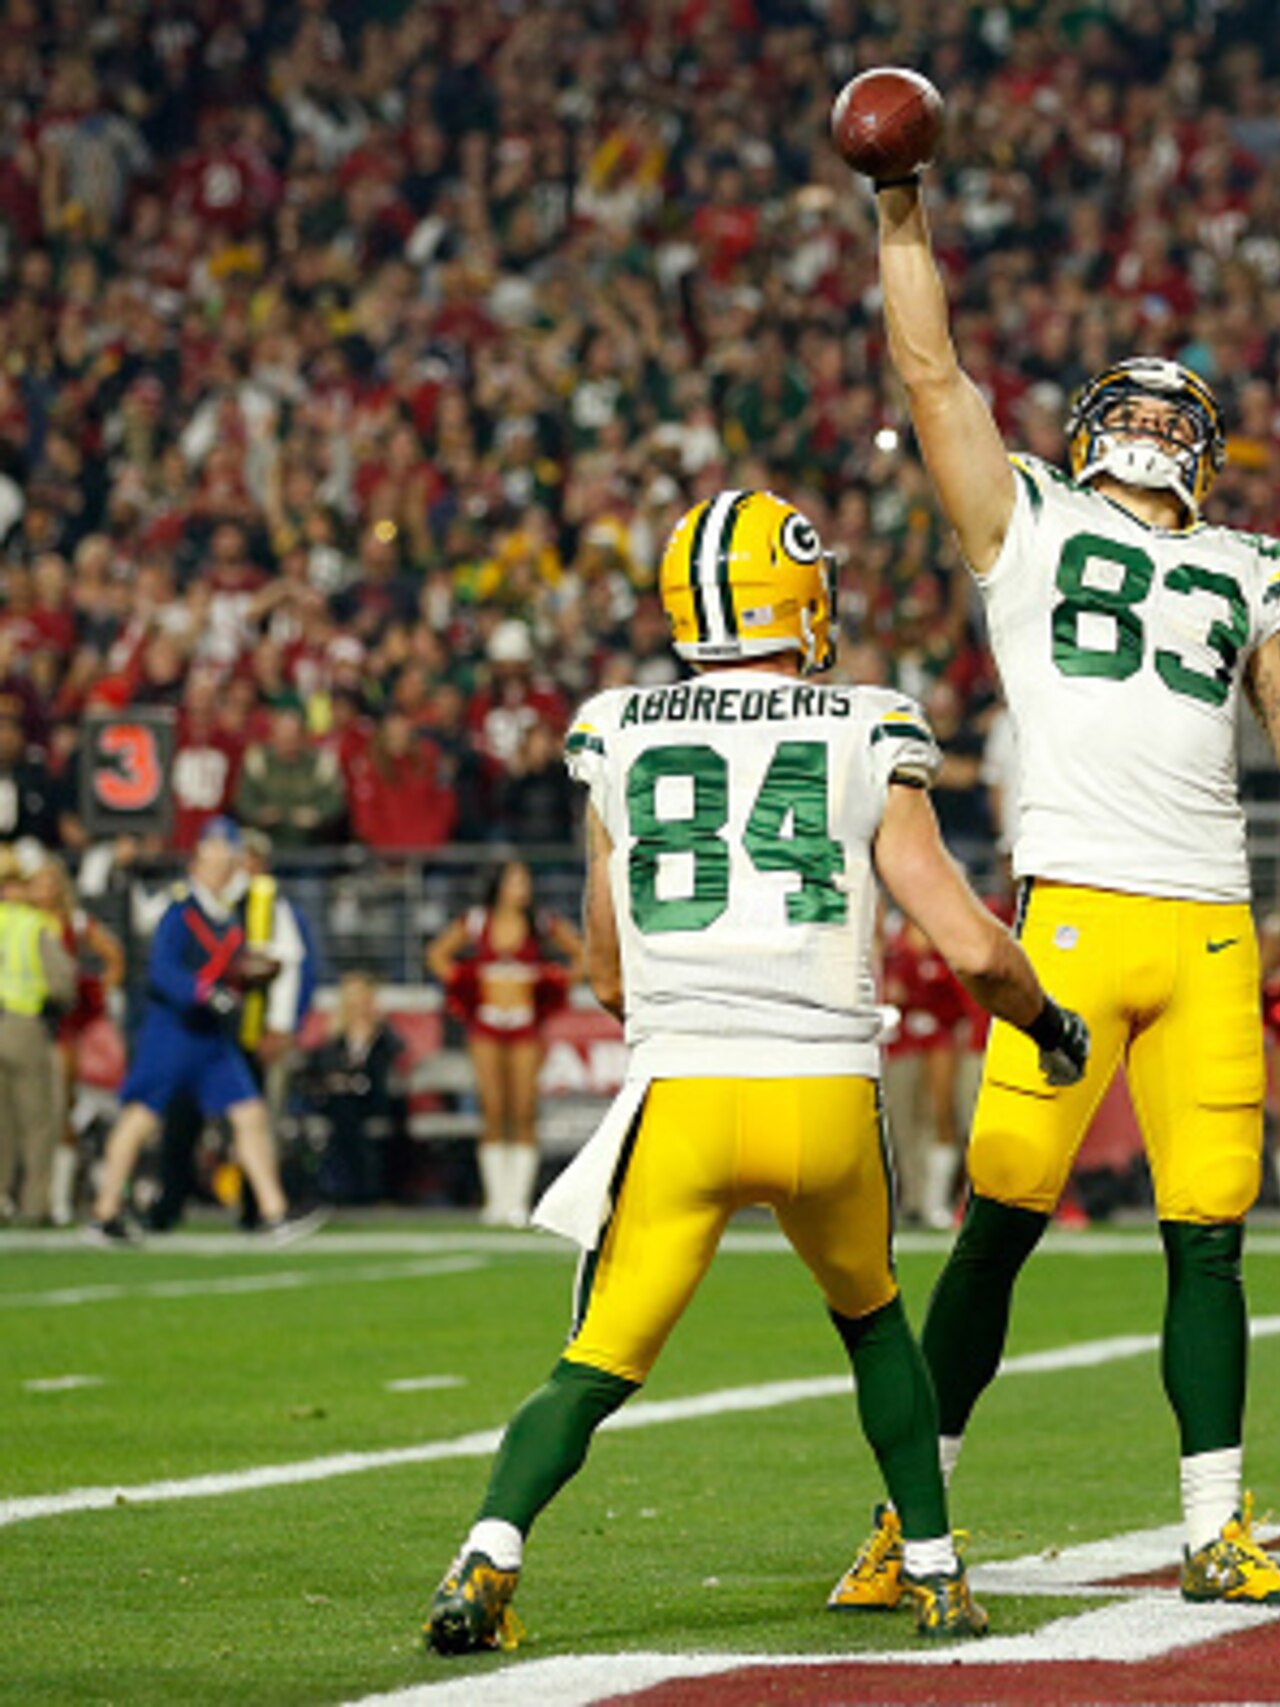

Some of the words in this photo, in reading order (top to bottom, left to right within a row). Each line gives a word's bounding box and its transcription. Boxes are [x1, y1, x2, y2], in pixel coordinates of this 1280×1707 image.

[1052, 531, 1249, 707] 83
[95, 723, 160, 810] 3
[620, 683, 851, 729] ABBREDERIS
[626, 740, 848, 935] 84
